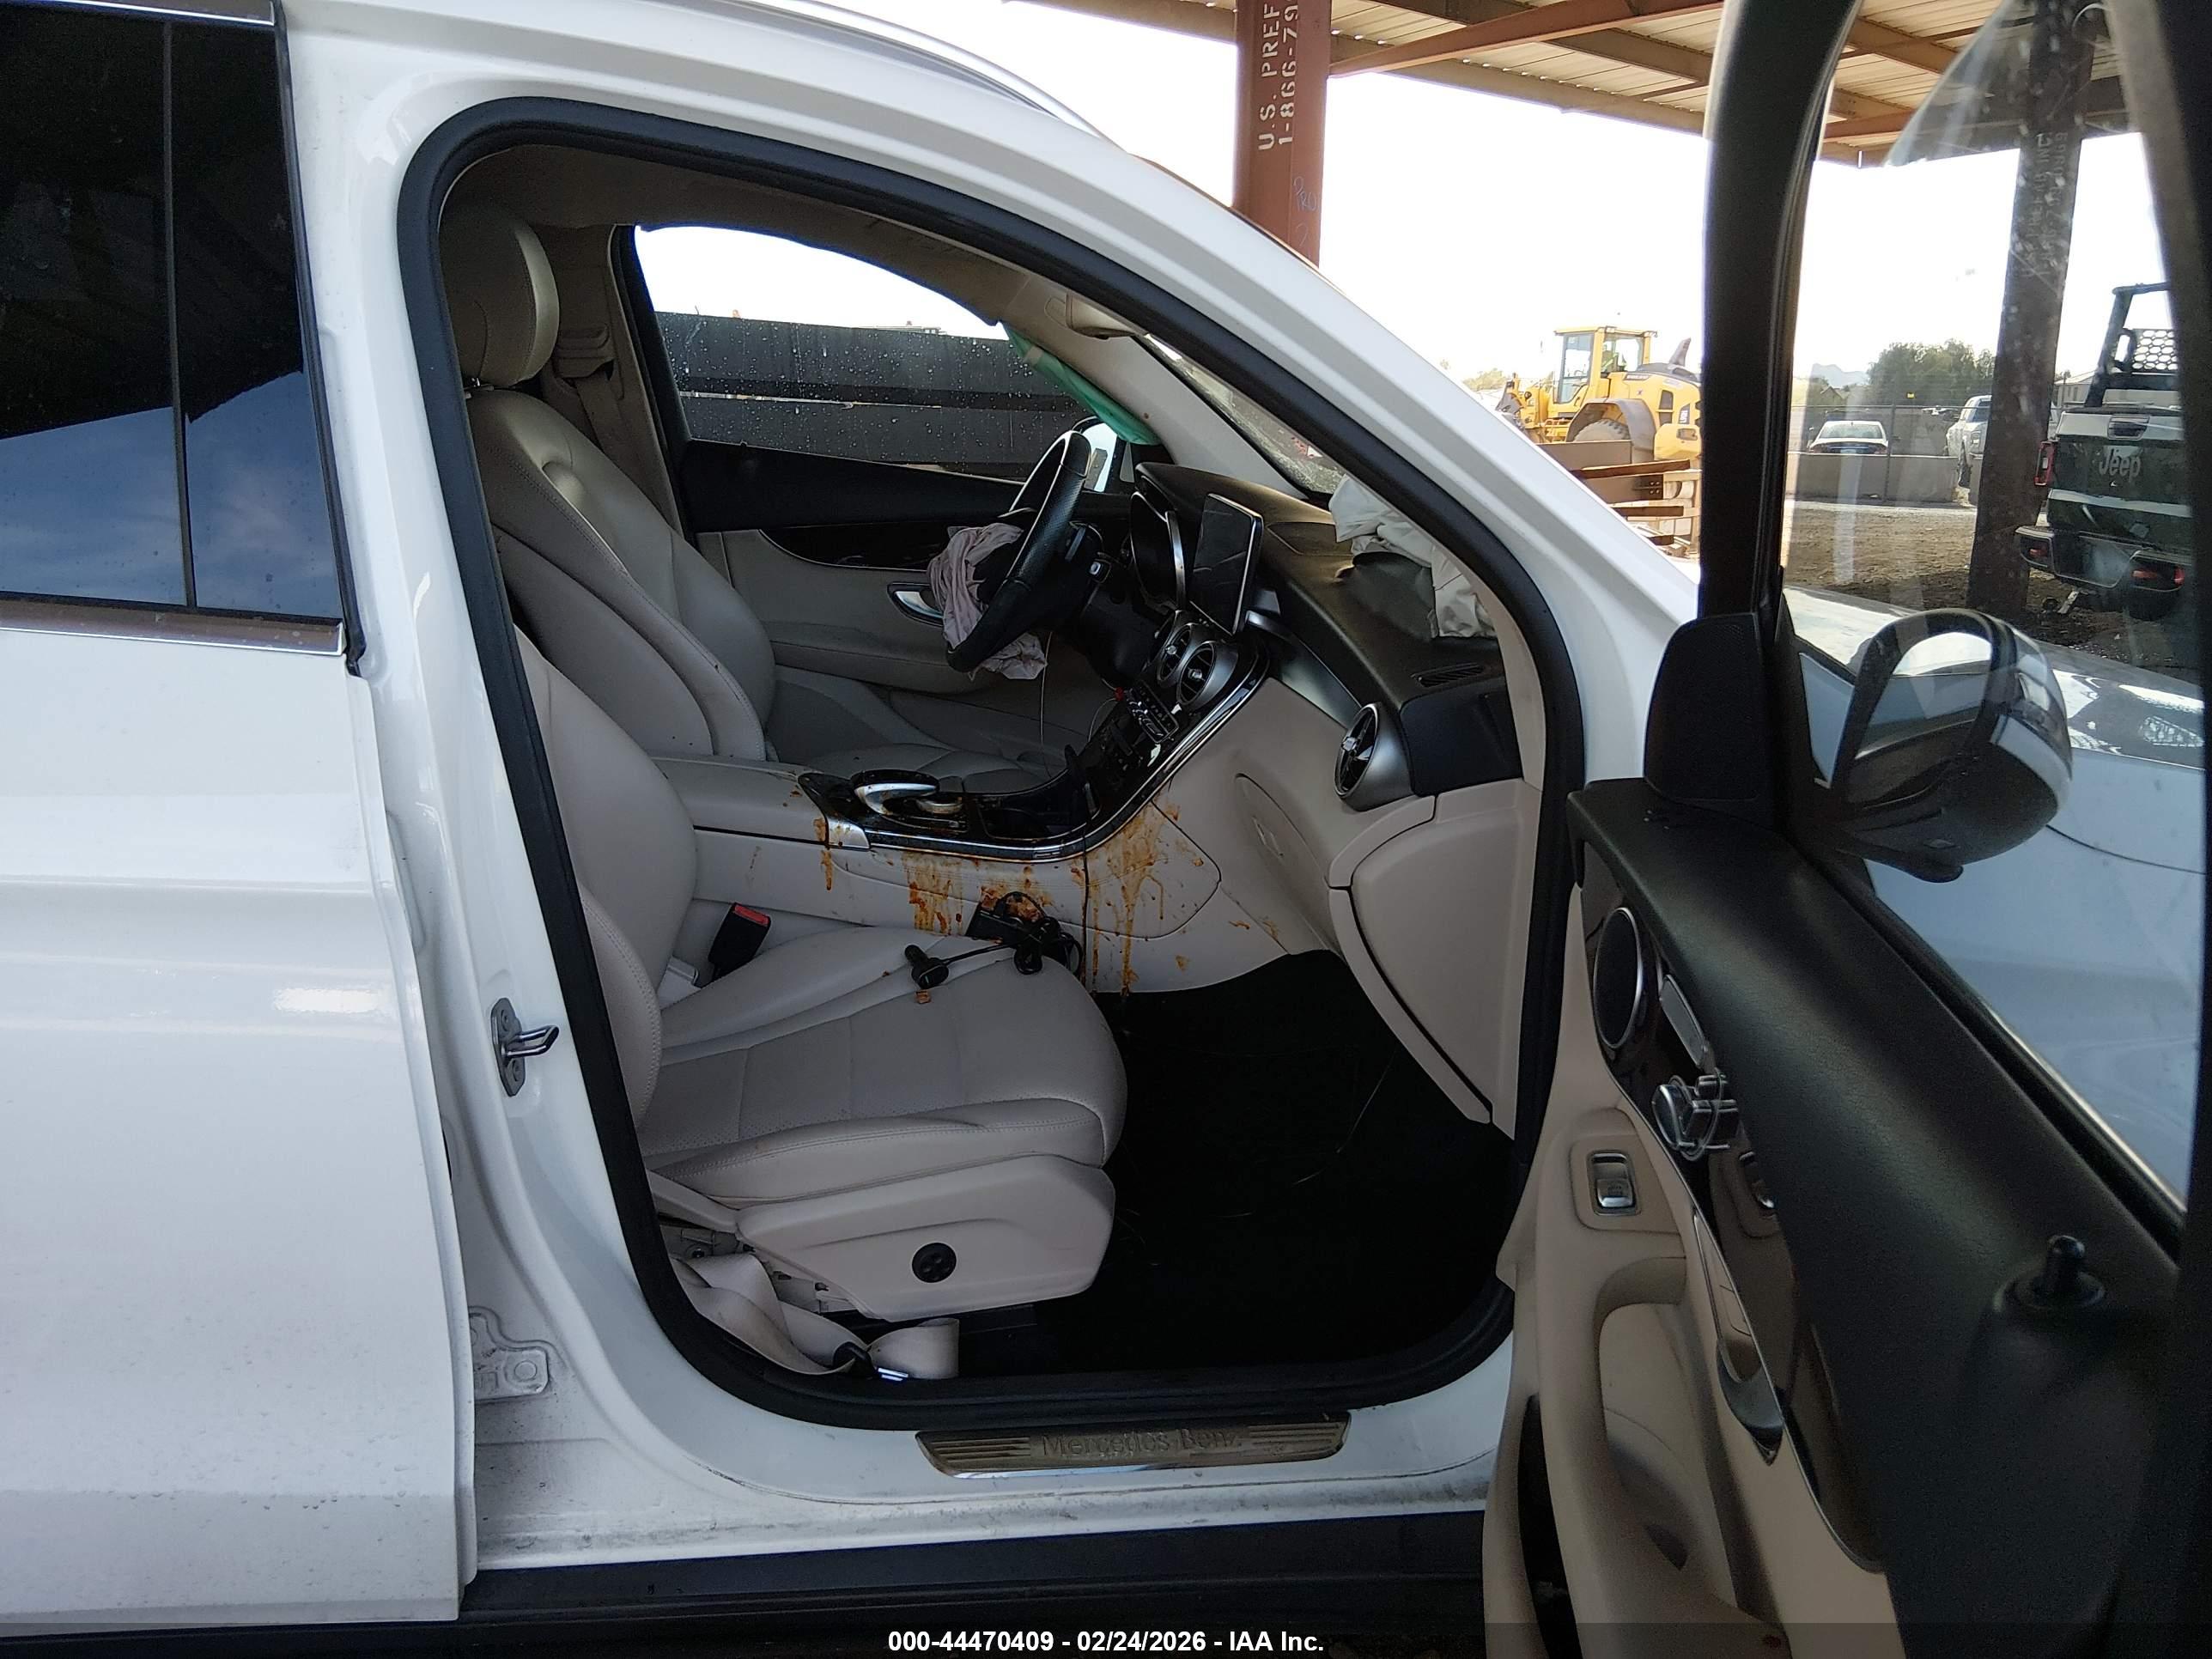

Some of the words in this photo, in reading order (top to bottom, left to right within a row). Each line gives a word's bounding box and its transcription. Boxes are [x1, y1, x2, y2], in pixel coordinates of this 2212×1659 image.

[1261, 3, 1280, 78] PREF
[1278, 0, 1298, 145] 1-866-79
[1258, 94, 1278, 151] U.S.
[2099, 447, 2141, 483] Jeep
